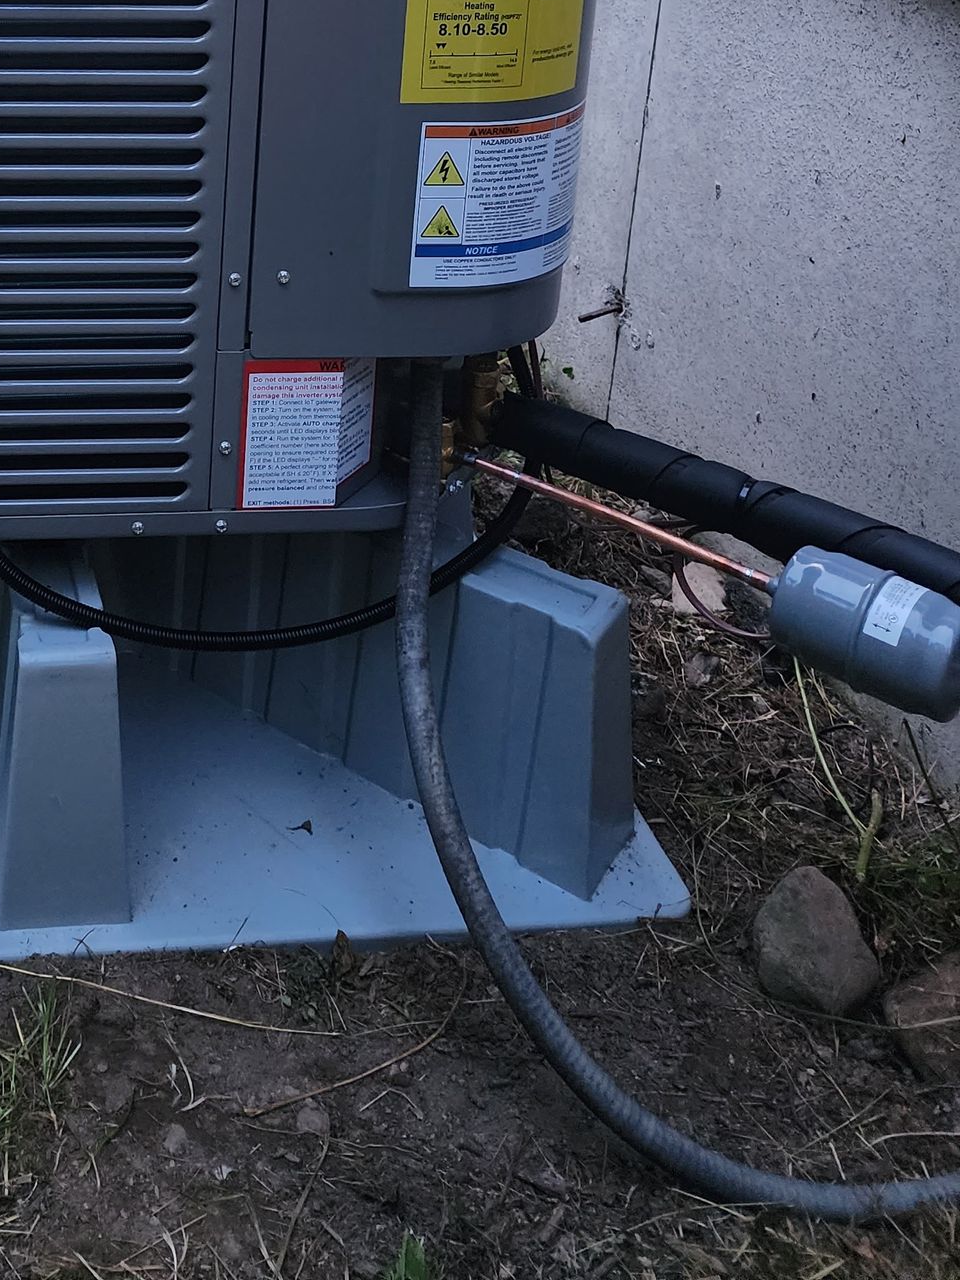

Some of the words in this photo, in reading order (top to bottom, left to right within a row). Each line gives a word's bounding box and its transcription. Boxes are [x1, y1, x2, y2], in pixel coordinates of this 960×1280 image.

[465, 2, 495, 11] Heating
[433, 13, 472, 22] Efficiency
[475, 13, 499, 21] Rating
[439, 23, 507, 36] 8.10-8.50
[477, 127, 519, 136] WARNING
[481, 137, 522, 146] HAZARDOUS
[465, 246, 498, 255] NOTICE
